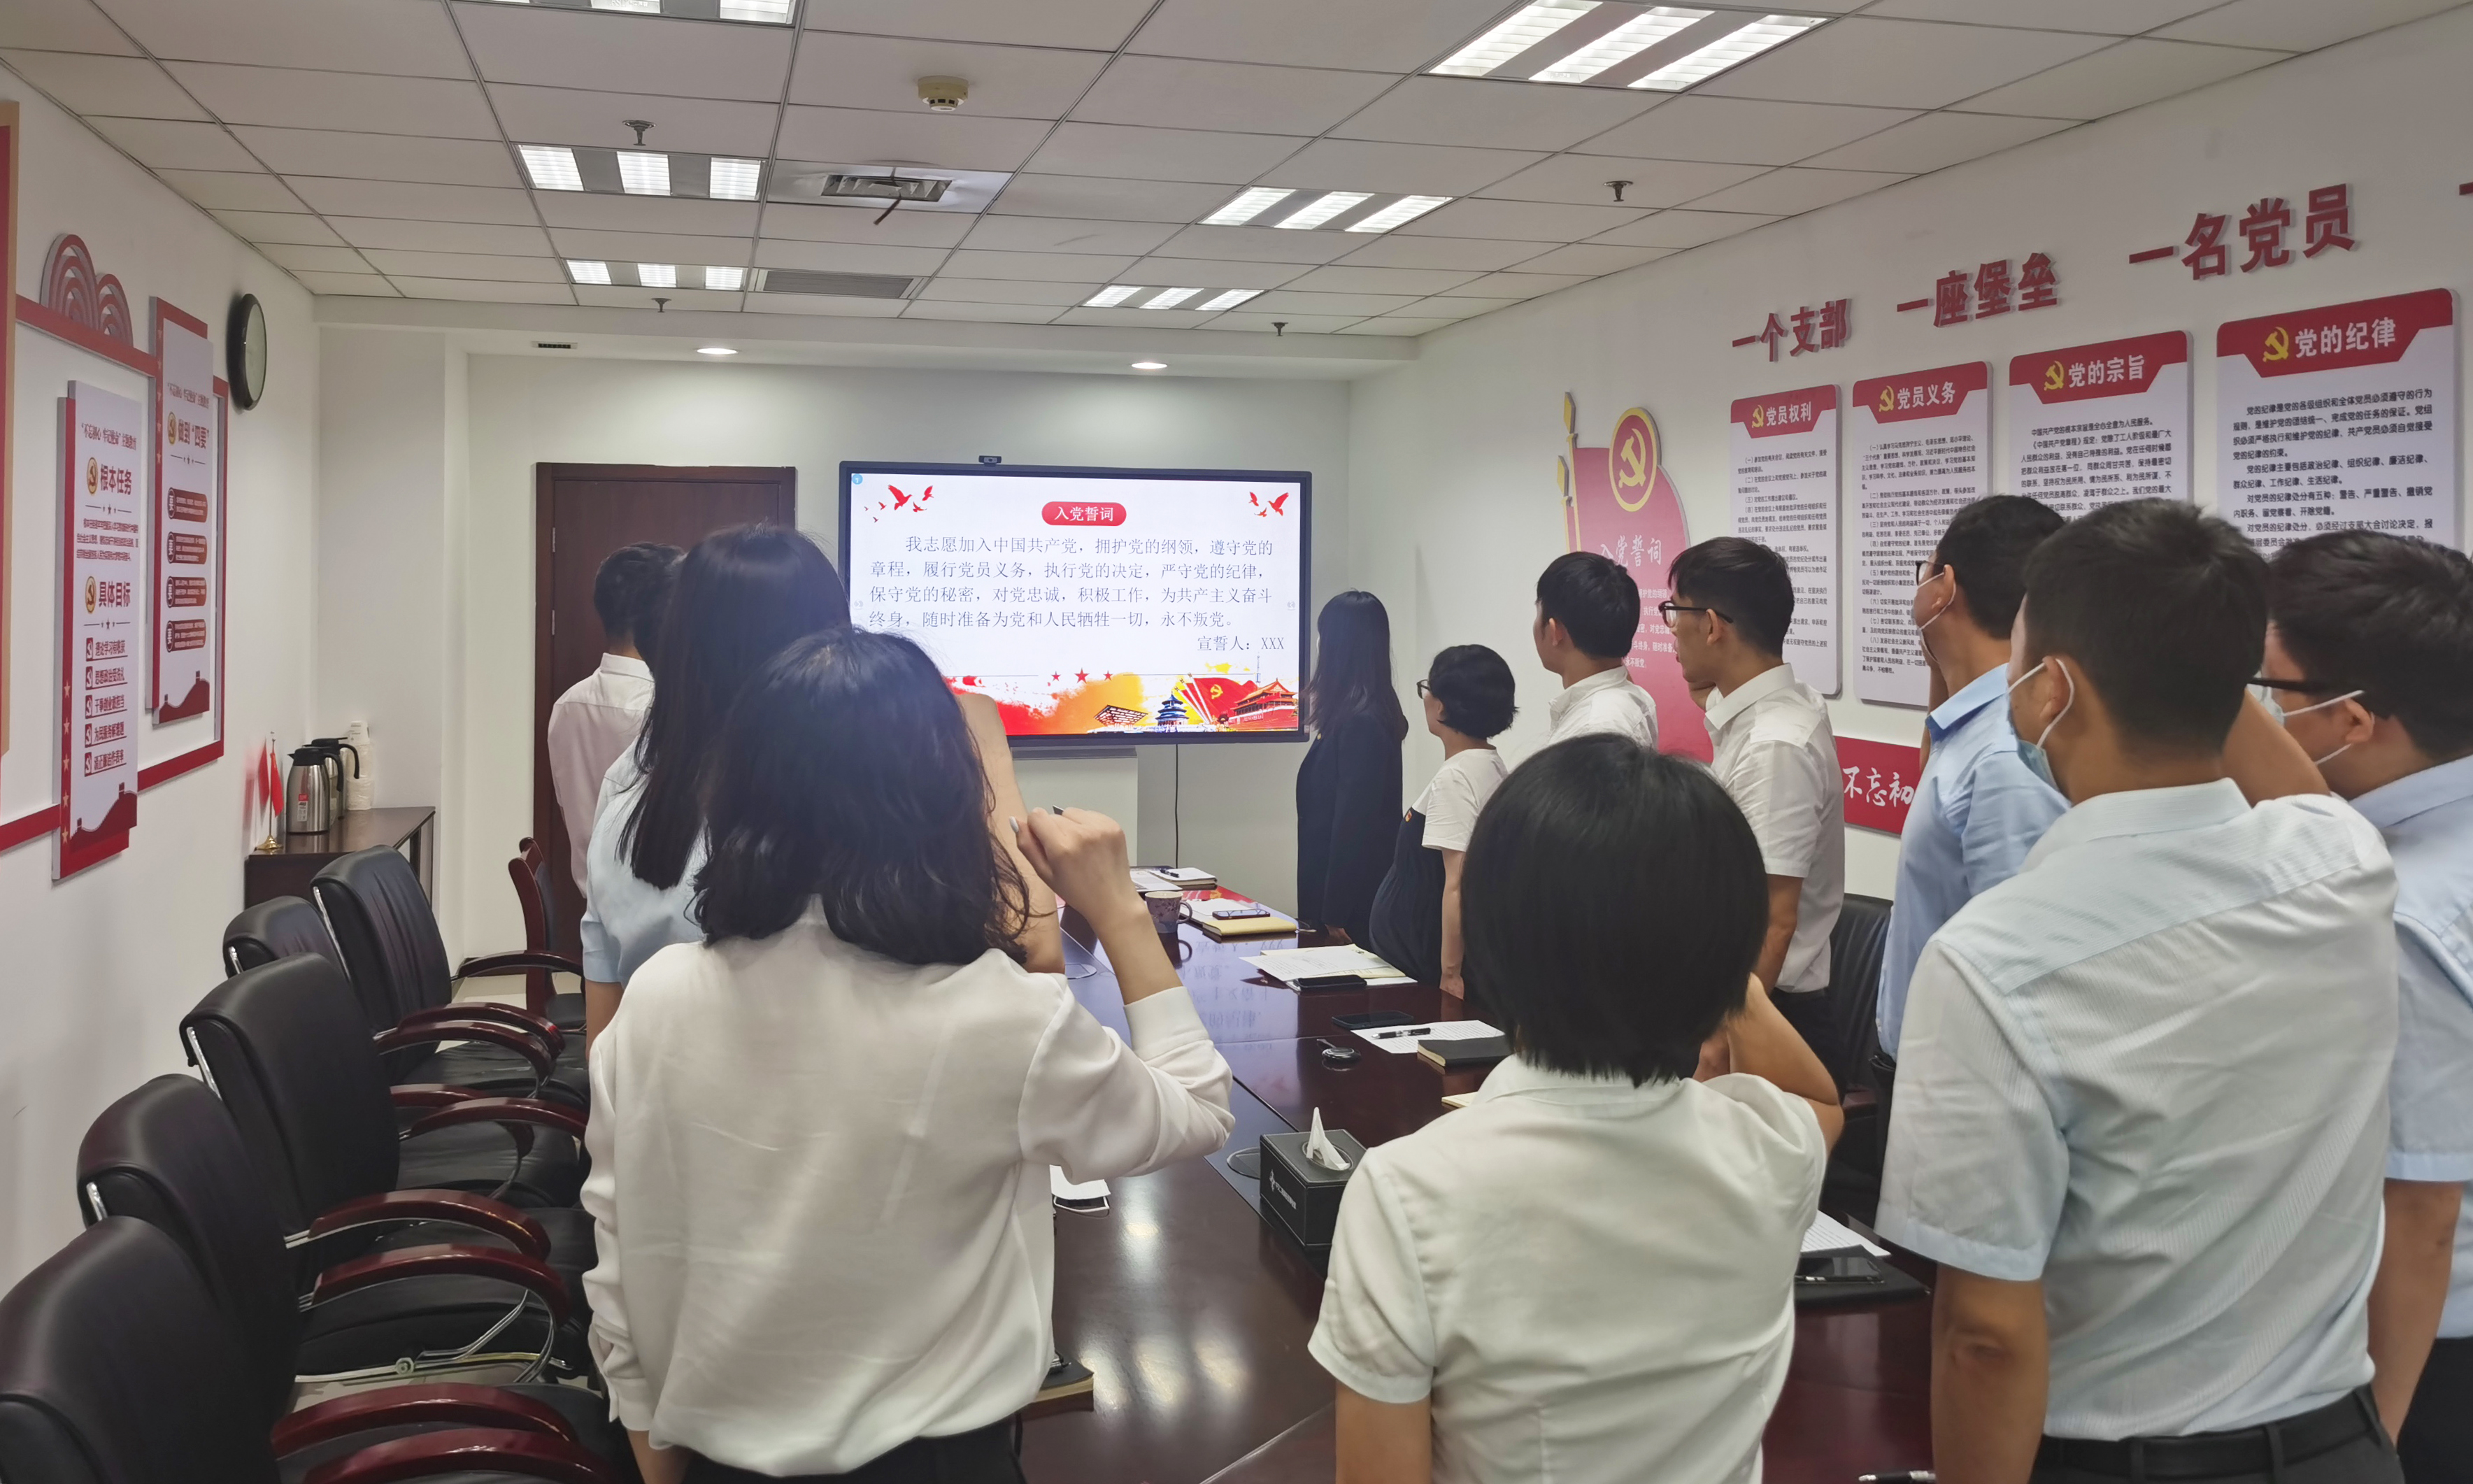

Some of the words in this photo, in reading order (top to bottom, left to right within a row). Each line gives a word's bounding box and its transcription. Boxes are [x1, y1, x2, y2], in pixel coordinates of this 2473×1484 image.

[2129, 183, 2356, 280] 一名党员
[1896, 252, 2058, 328] 一座堡垒
[1732, 299, 1850, 362] 一个支部
[2295, 317, 2396, 358] 党的纪律
[2068, 355, 2144, 387] 党的宗旨
[1897, 380, 1955, 411] 党员义务
[1766, 401, 1811, 427] 党员权利
[100, 464, 132, 495] 根本任务
[1054, 506, 1114, 522] 入党誓词
[906, 536, 1272, 556] 我志愿加入中国共产党，拥护党的纲领，遵守党的
[1600, 534, 1662, 568] 入党誓词
[870, 561, 1263, 579] 章程，履行党员义务，执行党的决定，严守党的纪律，
[99, 581, 131, 608] 具体目标
[869, 586, 1272, 604] 保守党的秘密，对党忠诚，积极工作，为共产主义奋斗
[869, 611, 1232, 627] 终身，随时准备为党和人民牺牲一切，永不叛党。
[1842, 765, 1915, 808] 不忘初
